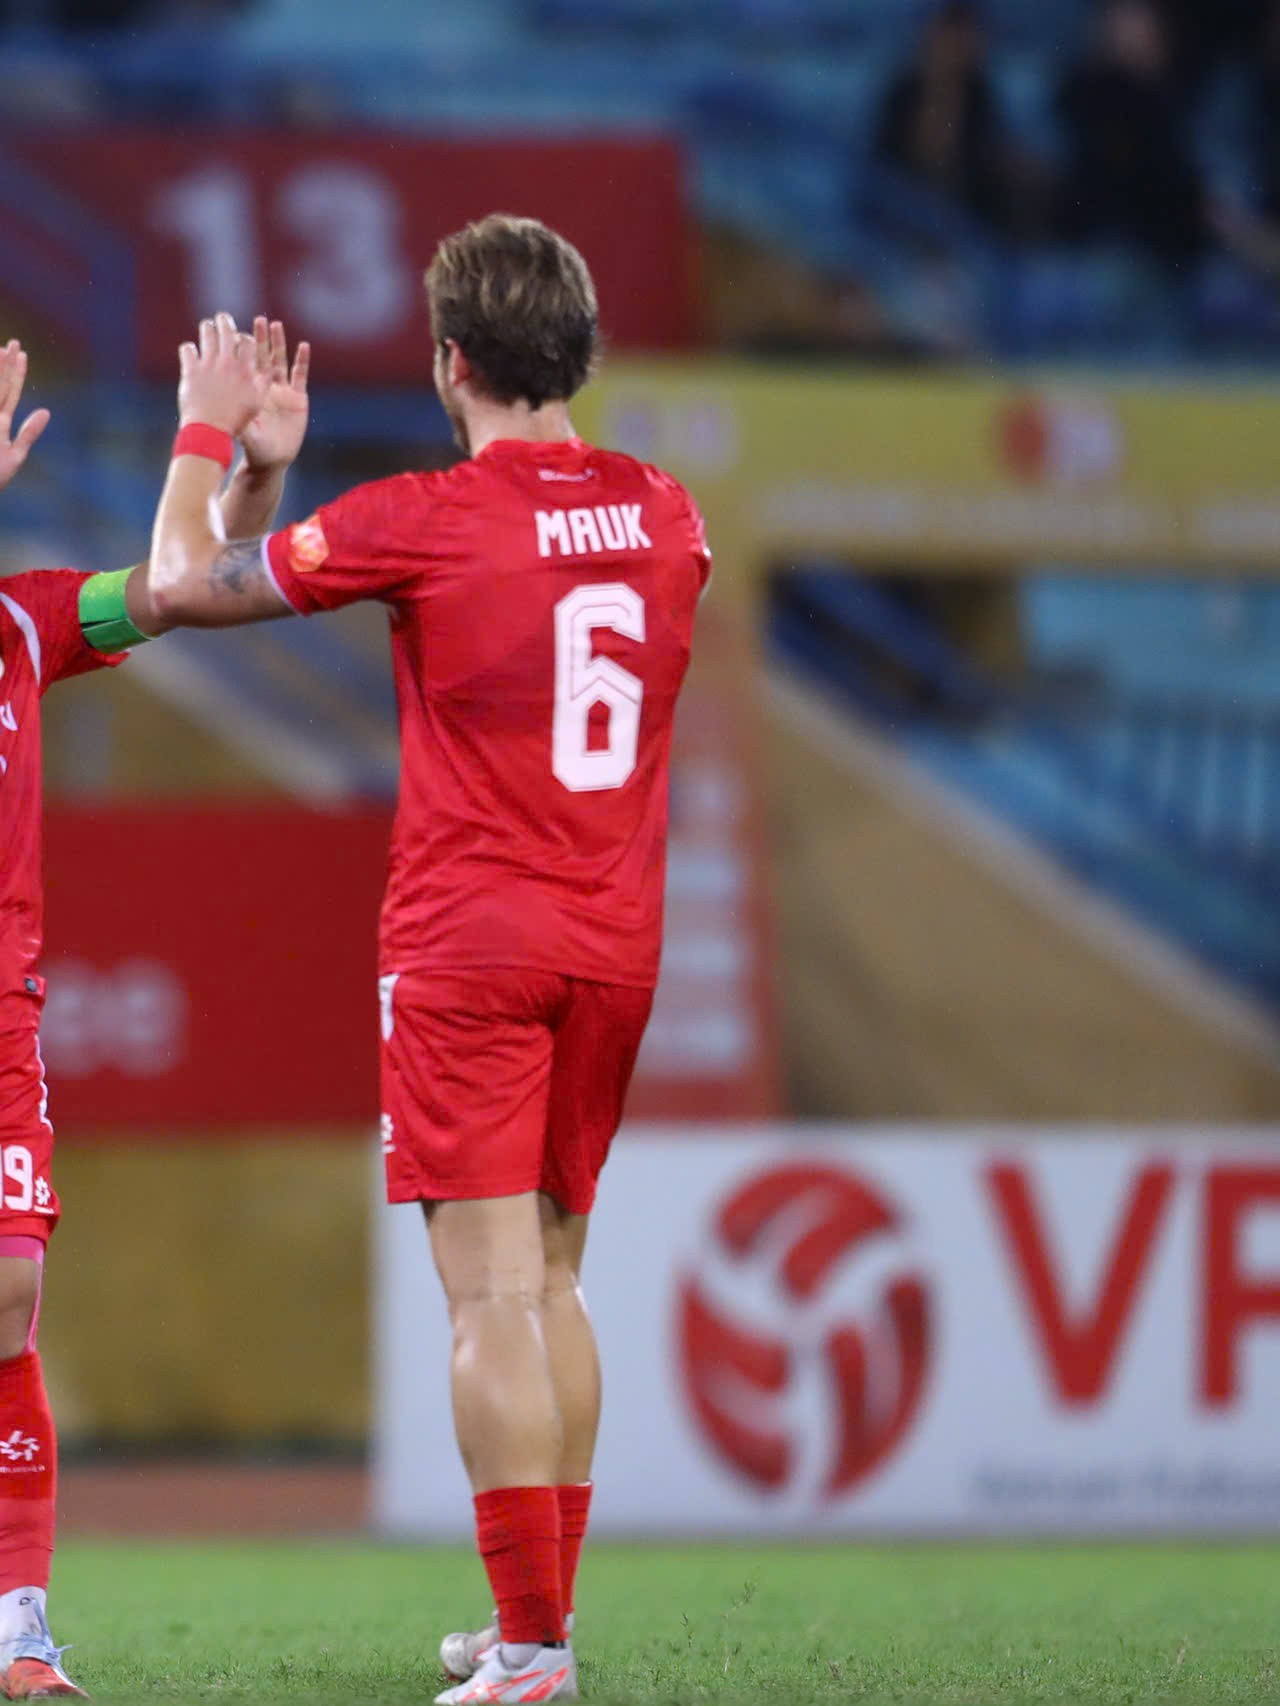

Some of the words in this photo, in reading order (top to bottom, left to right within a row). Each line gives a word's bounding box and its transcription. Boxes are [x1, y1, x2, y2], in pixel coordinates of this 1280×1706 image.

[154, 166, 408, 338] 13
[535, 503, 652, 558] MAUK
[552, 582, 645, 792] 6
